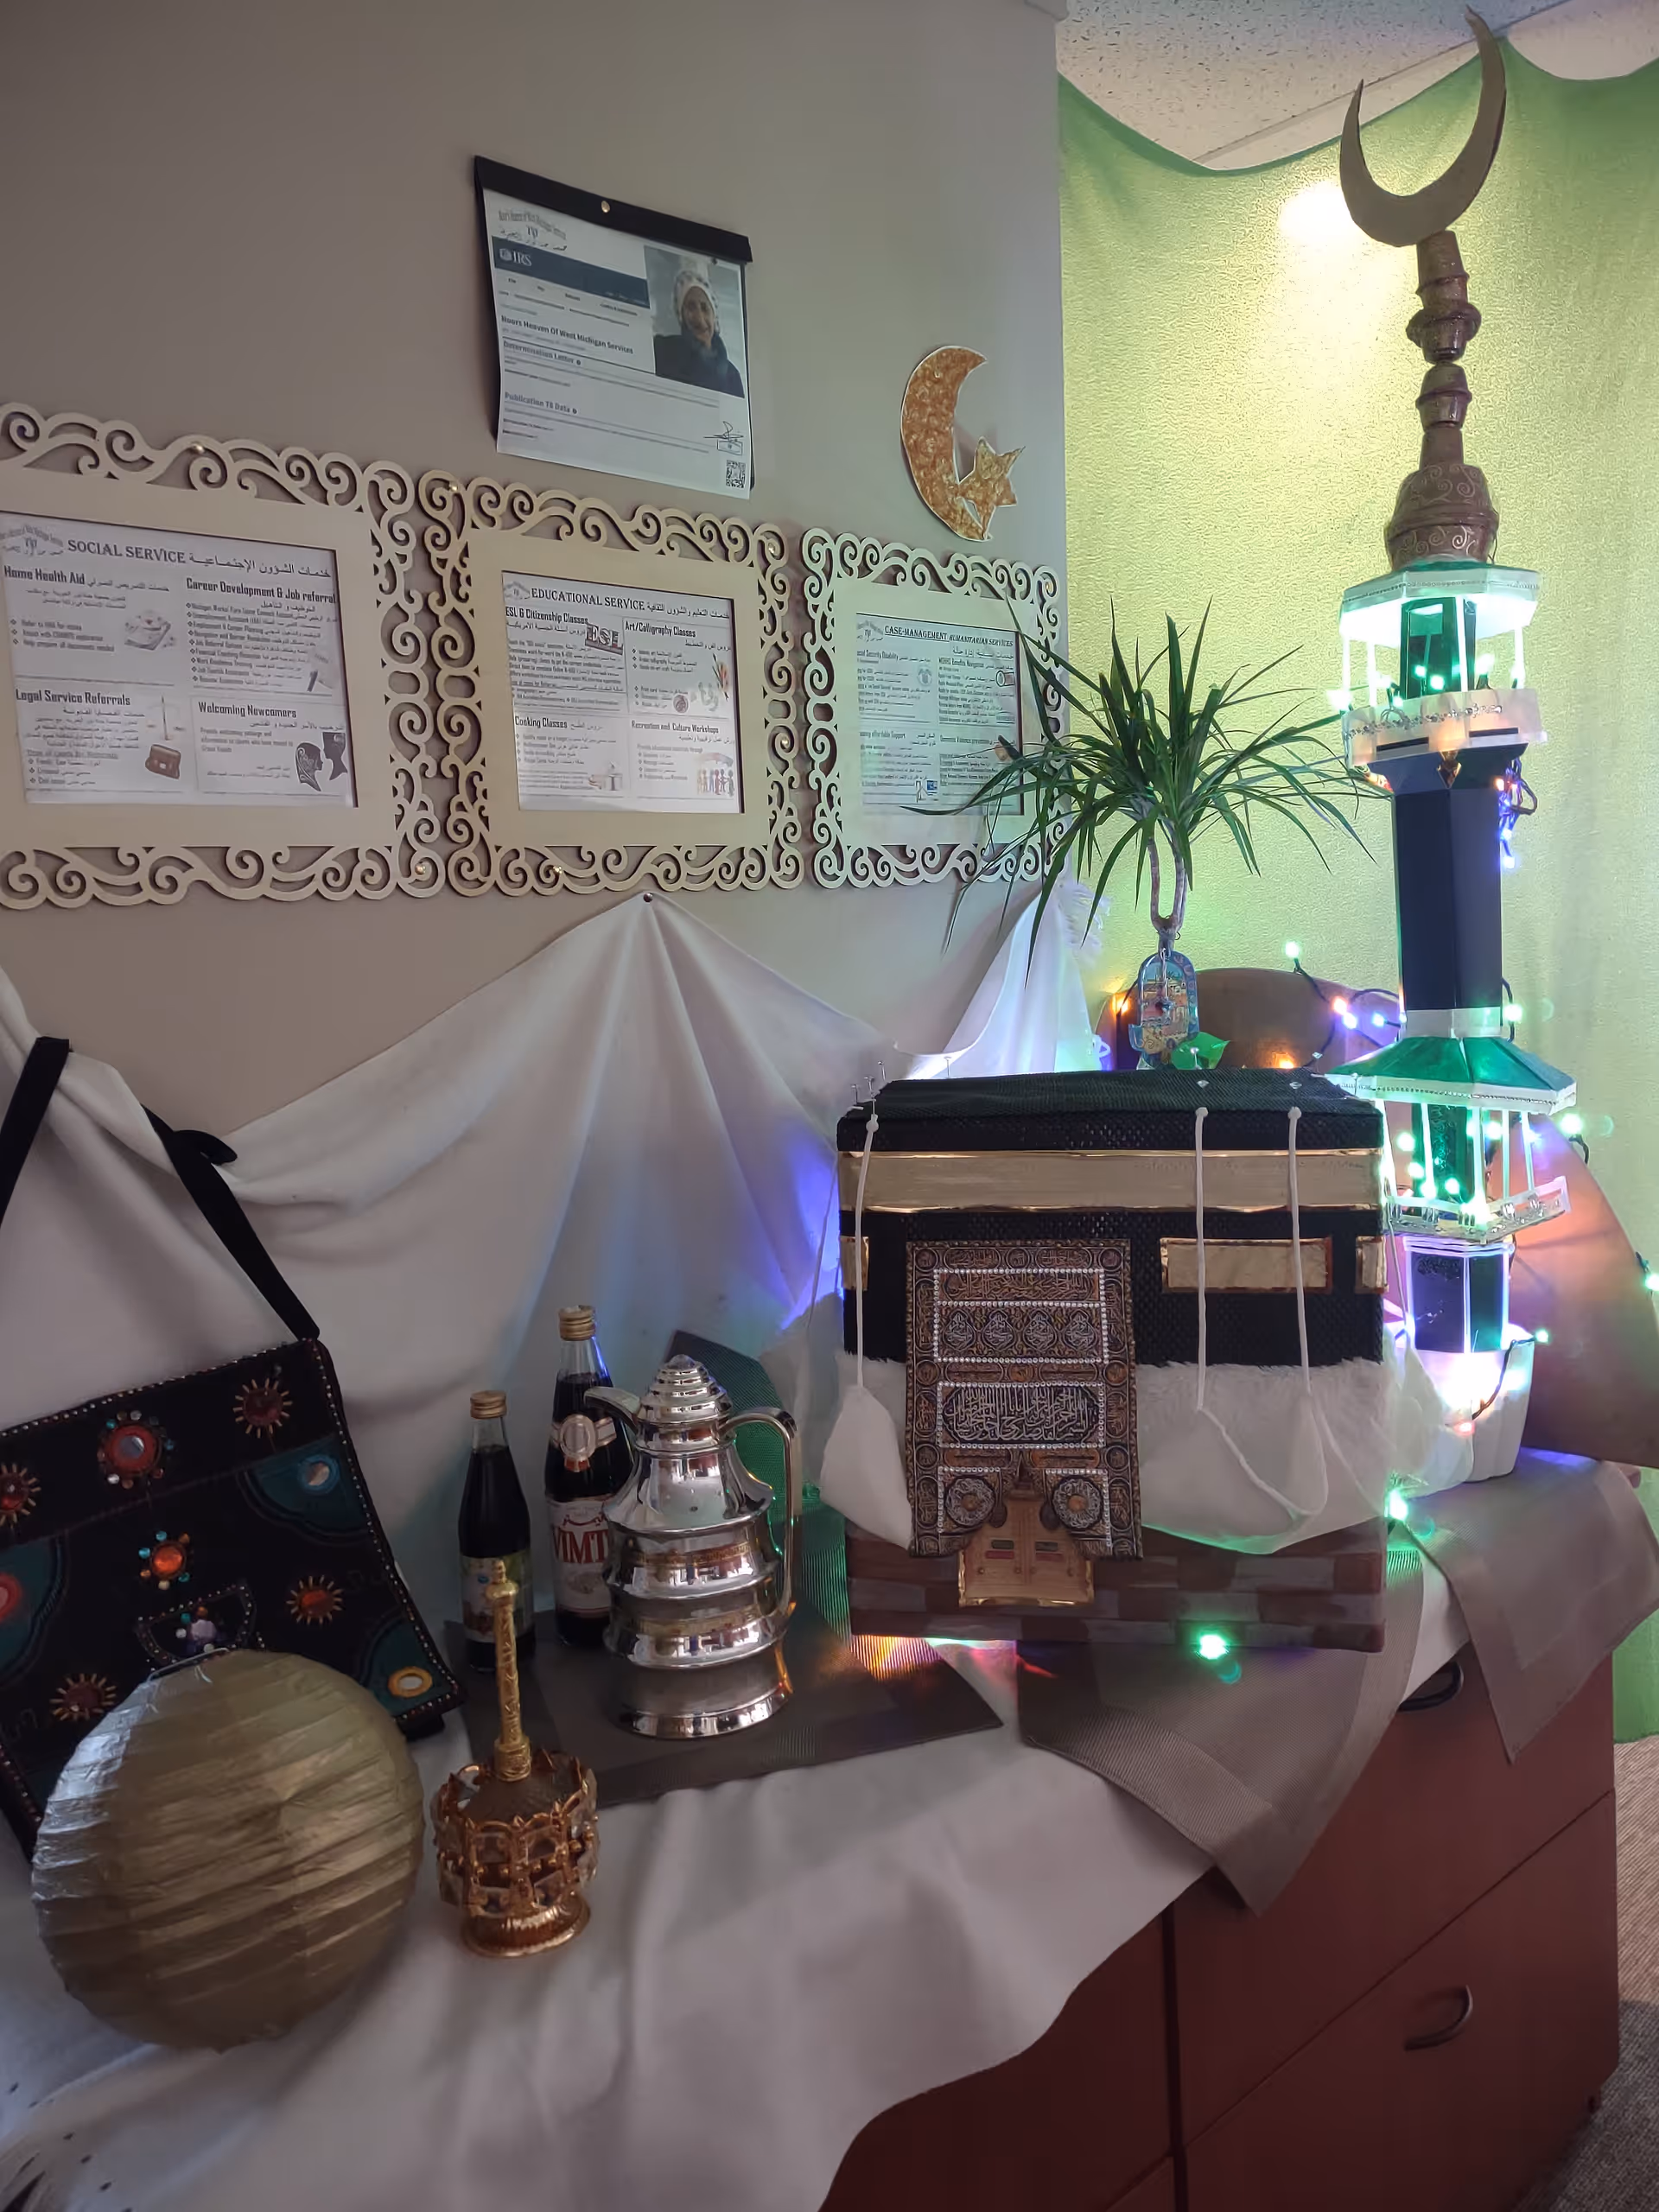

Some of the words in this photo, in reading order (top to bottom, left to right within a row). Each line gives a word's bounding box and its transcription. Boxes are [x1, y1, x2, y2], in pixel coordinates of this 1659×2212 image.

[512, 250, 532, 267] IRS
[559, 329, 576, 341] West
[577, 333, 607, 348] Michigan
[607, 341, 634, 355] Services
[505, 391, 544, 407] Publication
[68, 539, 123, 557] SOCIAL
[125, 546, 186, 563] SERVICE
[4, 564, 34, 581] Home
[35, 568, 67, 583] Health
[69, 571, 86, 586] Aid
[186, 577, 219, 593] Career
[219, 581, 276, 598] Development
[285, 588, 300, 601] Job
[302, 593, 336, 604] referral
[531, 588, 602, 606] EDUCATIONAL
[604, 596, 645, 611] SERVICE
[505, 606, 518, 618] ESL
[525, 608, 563, 624] Citizenship
[563, 613, 588, 625] Classes
[625, 620, 673, 637] Art/Calligraphy
[673, 626, 696, 638] Classes
[884, 625, 948, 640] CASE-MANAGEMENT
[949, 633, 989, 646] HUMANITARIAN
[988, 639, 1014, 647] SERVICES
[16, 689, 42, 703] Legal
[44, 690, 83, 704] Service
[85, 692, 130, 706] Referrals
[198, 702, 246, 717] Welcoming
[247, 704, 297, 718] Newcomers
[514, 715, 541, 729] Cooking
[542, 717, 568, 729] Classes
[631, 720, 660, 731] Recreation
[660, 721, 671, 731] and
[672, 722, 691, 733] Culture
[692, 724, 719, 734] Workshops
[552, 1527, 610, 1565] VIMT
